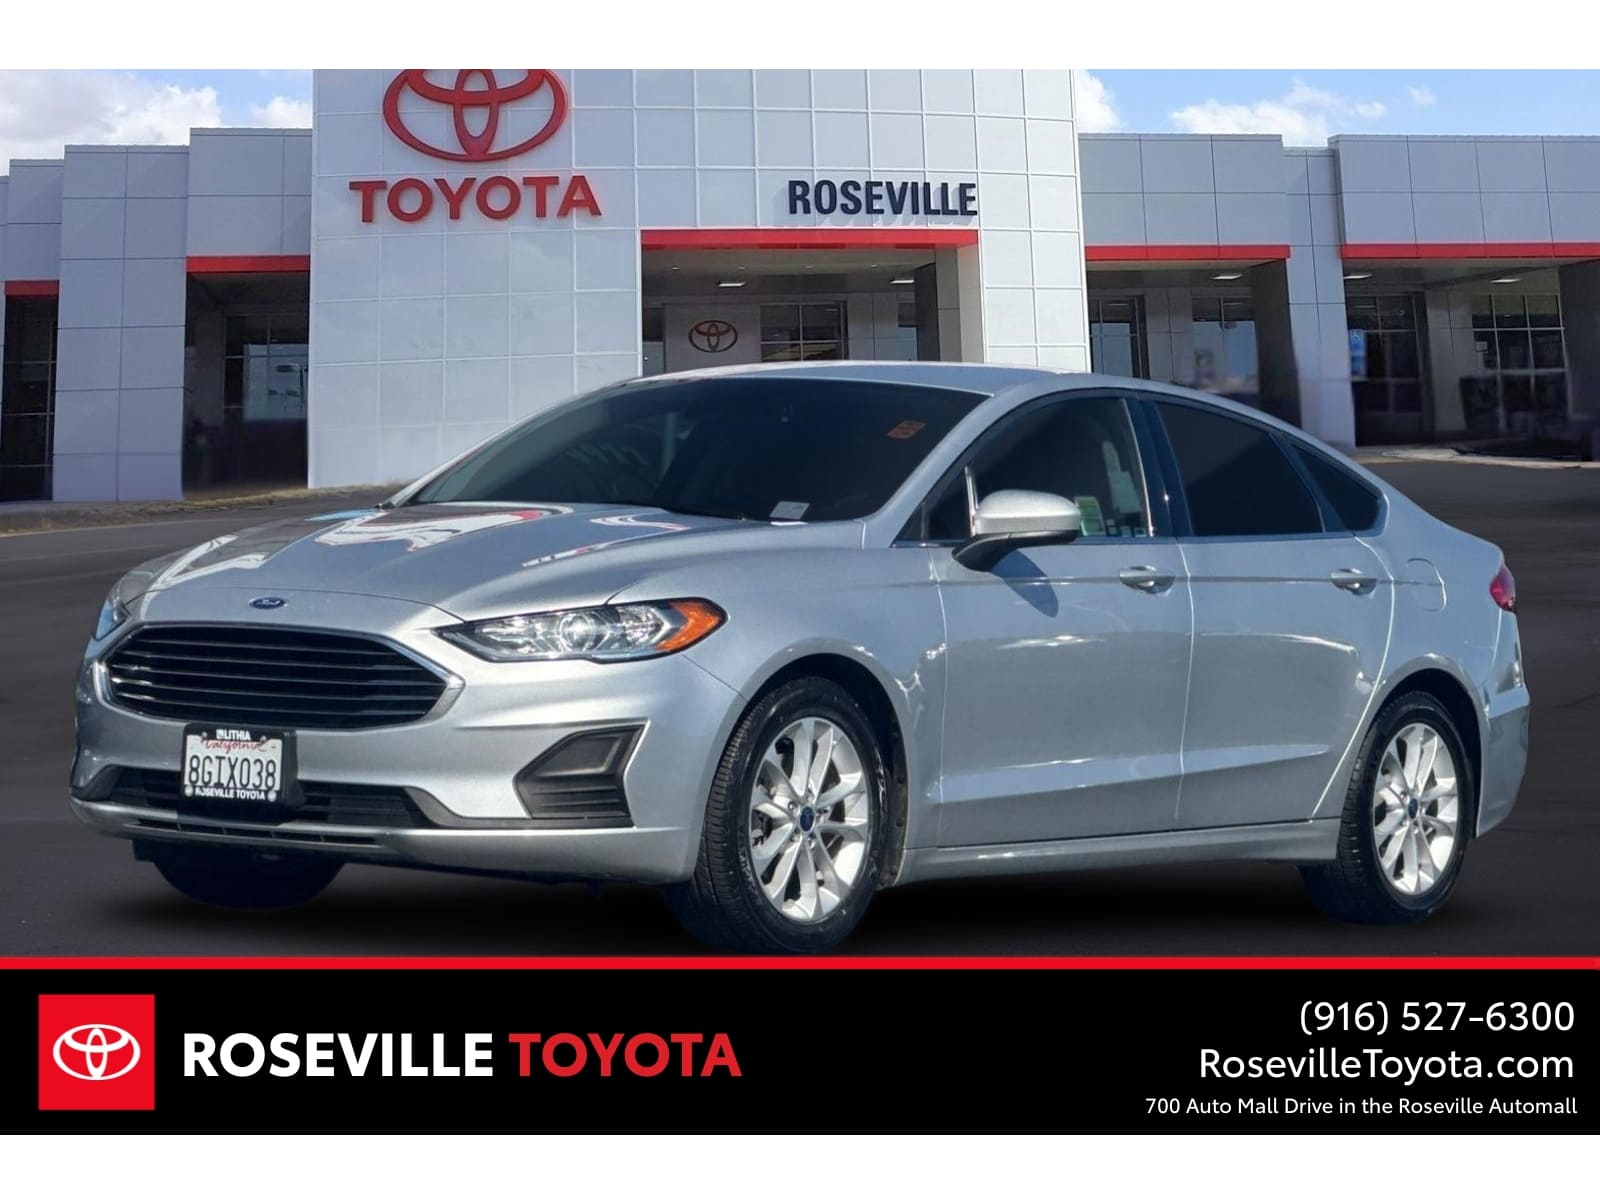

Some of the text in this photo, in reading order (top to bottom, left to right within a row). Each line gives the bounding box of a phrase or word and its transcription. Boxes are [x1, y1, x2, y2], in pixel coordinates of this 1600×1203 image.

[350, 176, 602, 223] TOYOTA
[788, 180, 978, 216] ROSEVILLE
[194, 787, 265, 800] ROSEVILLE TOYOTA
